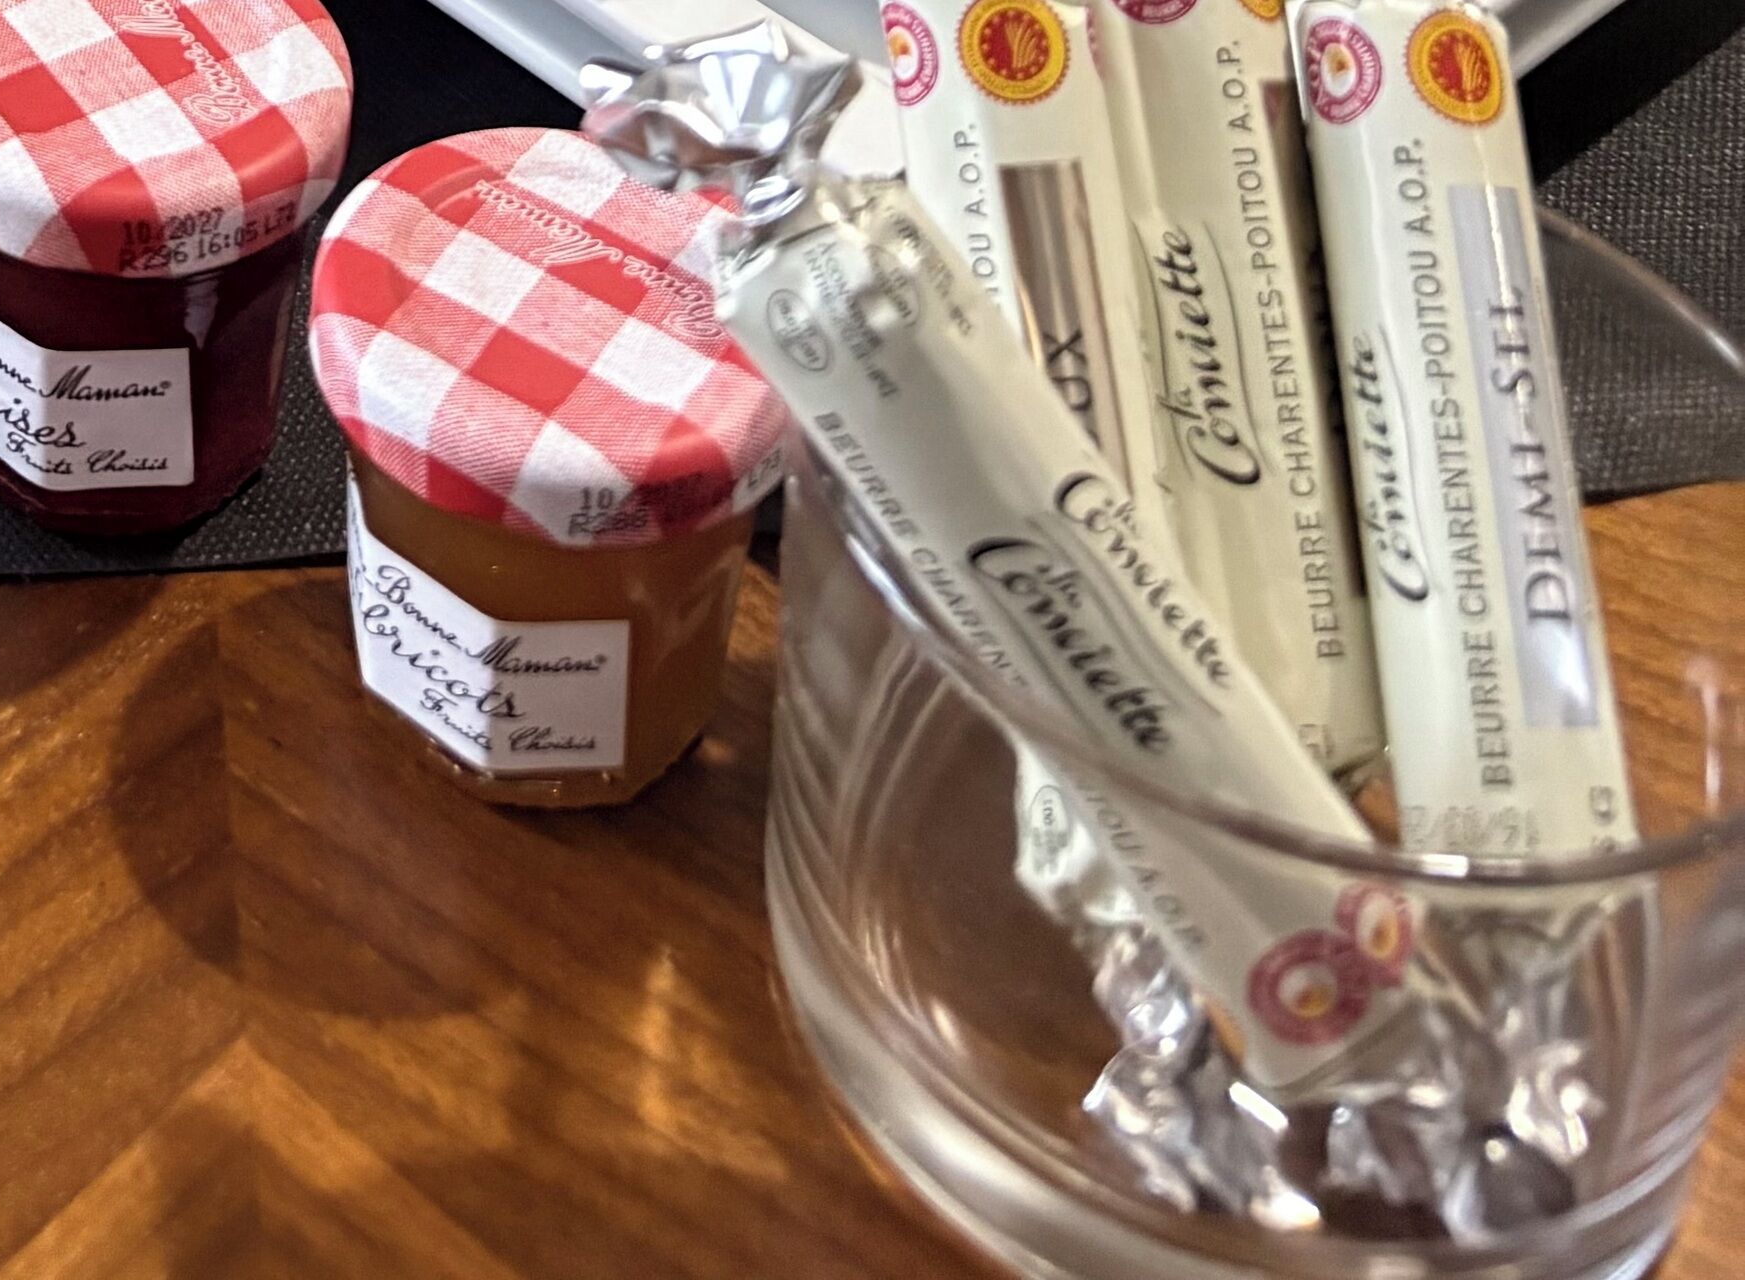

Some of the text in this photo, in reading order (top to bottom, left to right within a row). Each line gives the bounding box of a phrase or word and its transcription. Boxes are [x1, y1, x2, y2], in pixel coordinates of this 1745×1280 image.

[953, 122, 987, 217] A.O.P.
[1216, 39, 1344, 660] BEURRE CHARENTES-POITOU A.O.P.
[6, 431, 169, 475] Fruits Choisis
[1394, 137, 1513, 789] BEURRE CHARENTES-POITOU A.O.P.
[1488, 285, 1573, 625] DEMI-SEL
[377, 563, 461, 651] Bonne
[419, 686, 598, 753] Fruits Choisis
